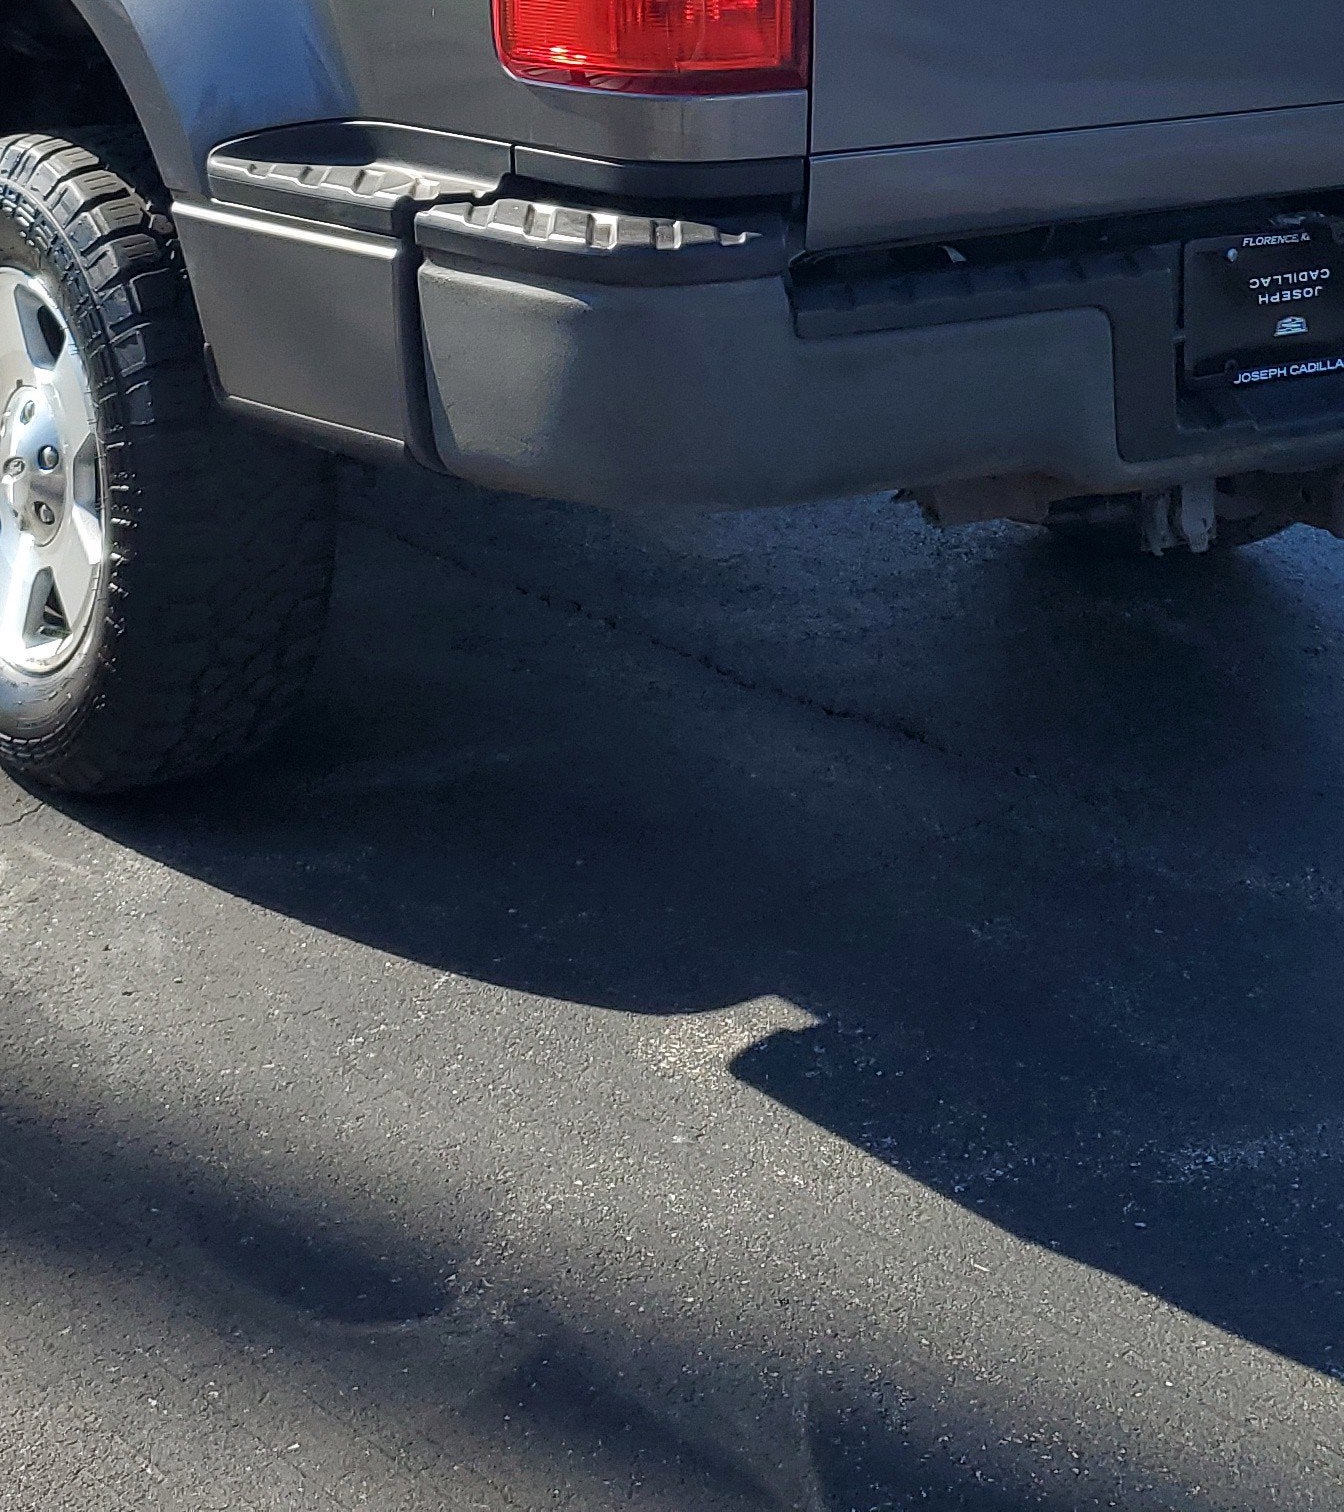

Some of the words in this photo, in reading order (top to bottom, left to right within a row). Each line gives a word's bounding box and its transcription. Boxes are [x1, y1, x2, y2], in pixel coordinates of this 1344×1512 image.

[1242, 233, 1300, 247] FLORENCE
[1248, 268, 1331, 289] CADILLAC
[1258, 286, 1324, 305] JOSEPH
[1233, 366, 1288, 385] JOSEPH
